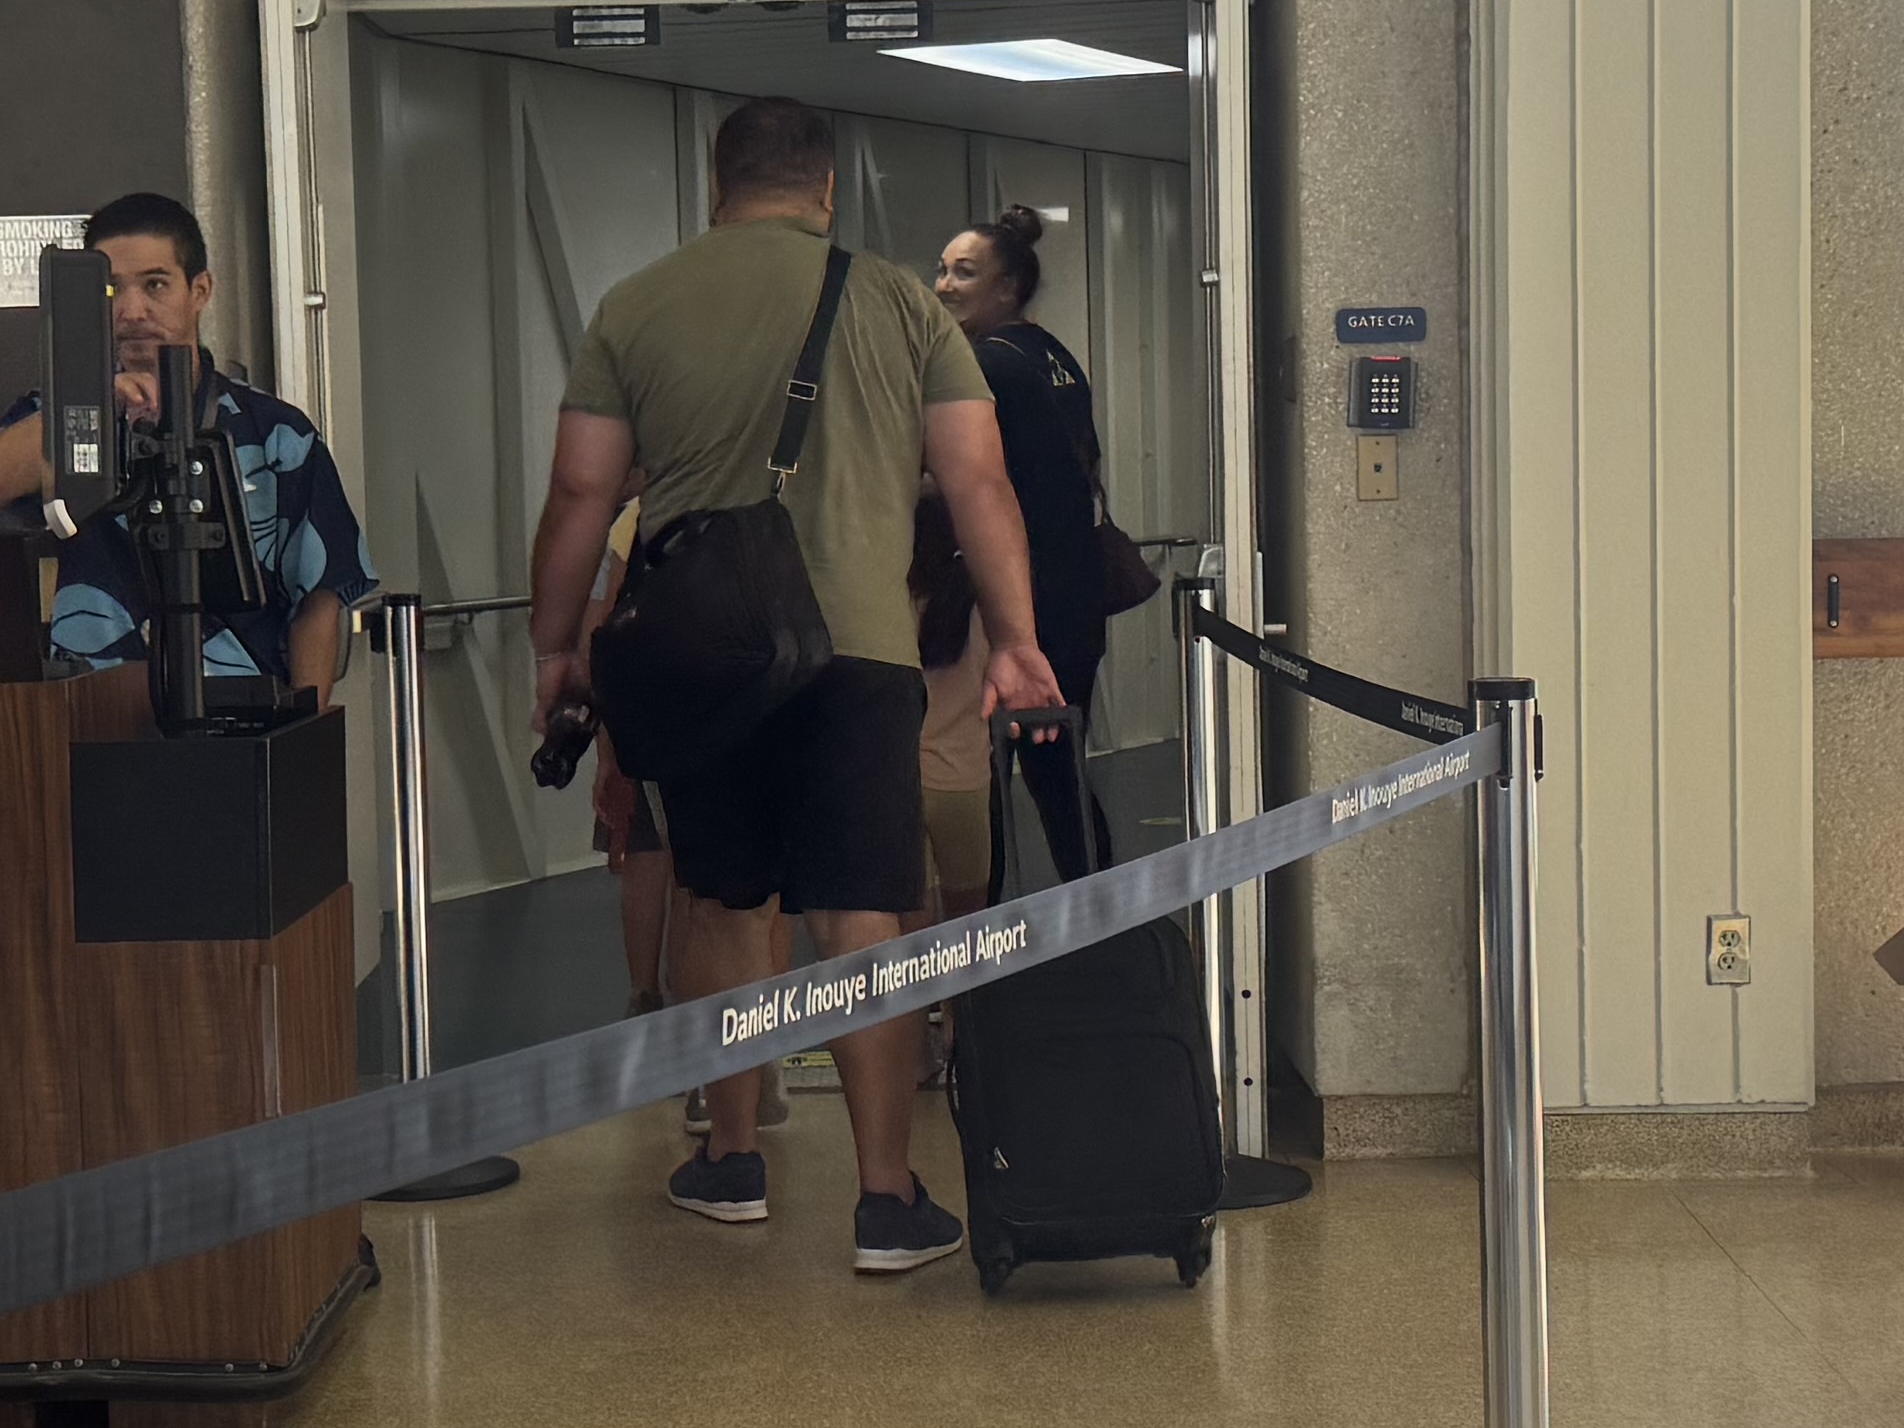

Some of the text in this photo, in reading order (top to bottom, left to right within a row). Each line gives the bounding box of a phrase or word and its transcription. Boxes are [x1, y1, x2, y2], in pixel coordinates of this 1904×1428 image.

[2, 258, 25, 276] BY
[1348, 314, 1415, 328] GATE C7A
[1331, 788, 1359, 824] Daniel
[1398, 756, 1444, 797] International
[1445, 749, 1470, 780] Airport
[721, 918, 1028, 1047] Daniel K. Inouye International Airport
